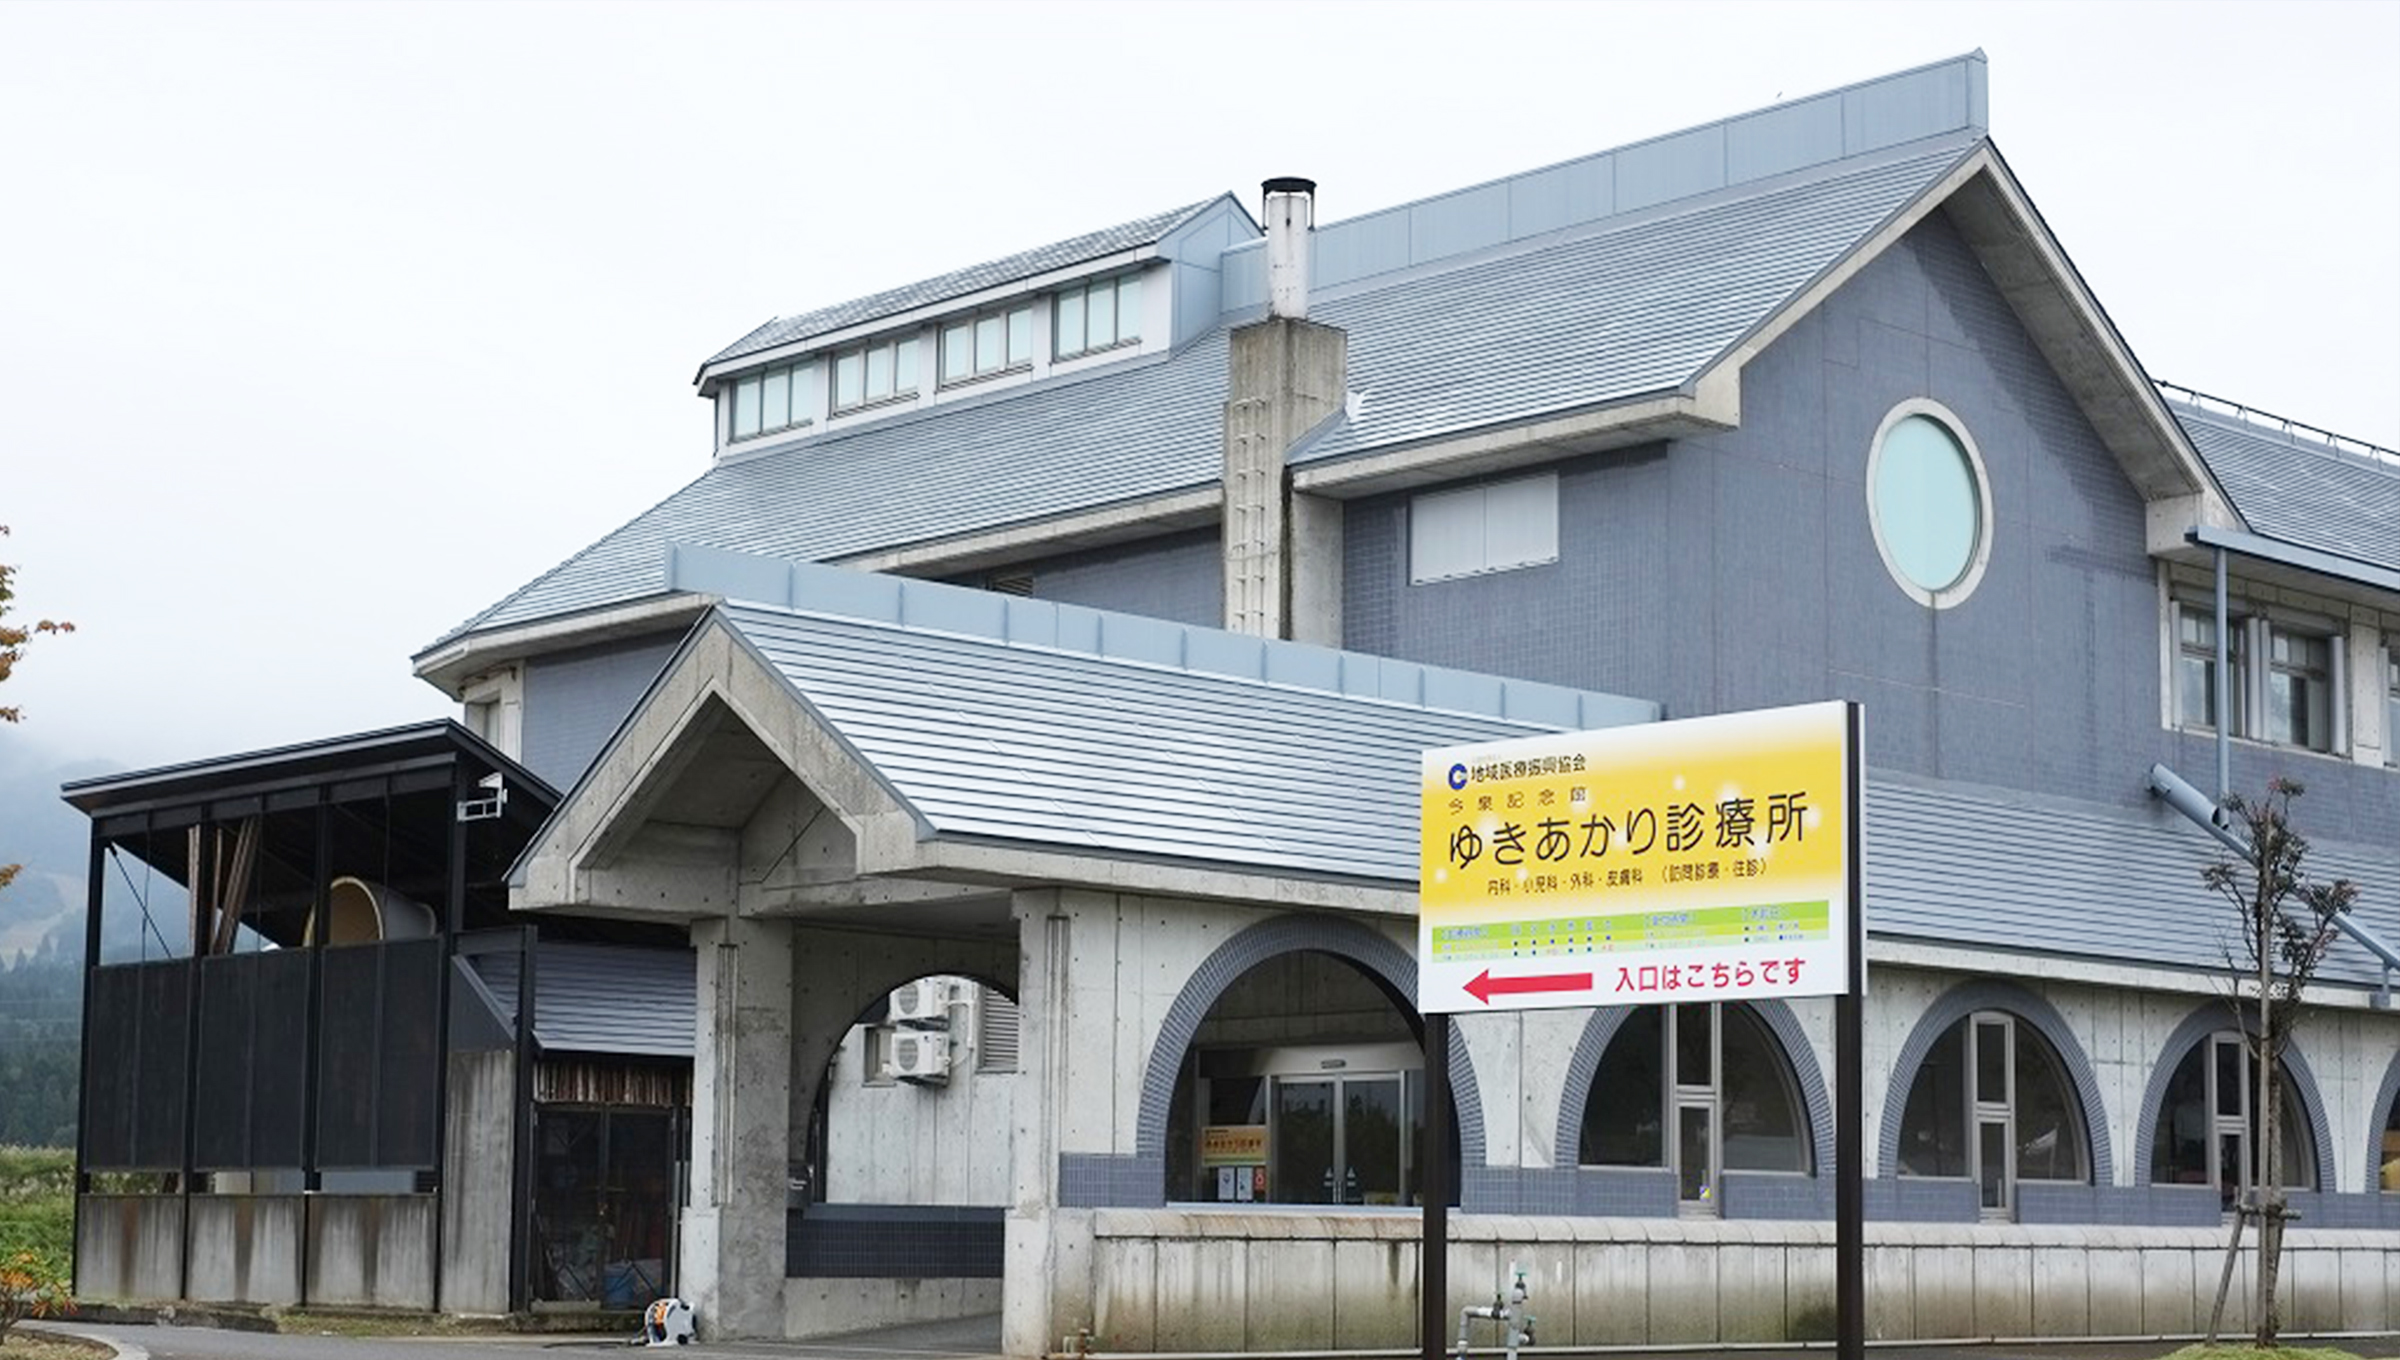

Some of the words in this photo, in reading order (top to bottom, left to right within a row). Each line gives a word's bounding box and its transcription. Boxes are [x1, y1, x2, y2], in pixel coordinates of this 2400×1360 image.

[1450, 791, 1808, 870] ゆきあかり診療所
[1615, 957, 1806, 992] 入口はこちらです
